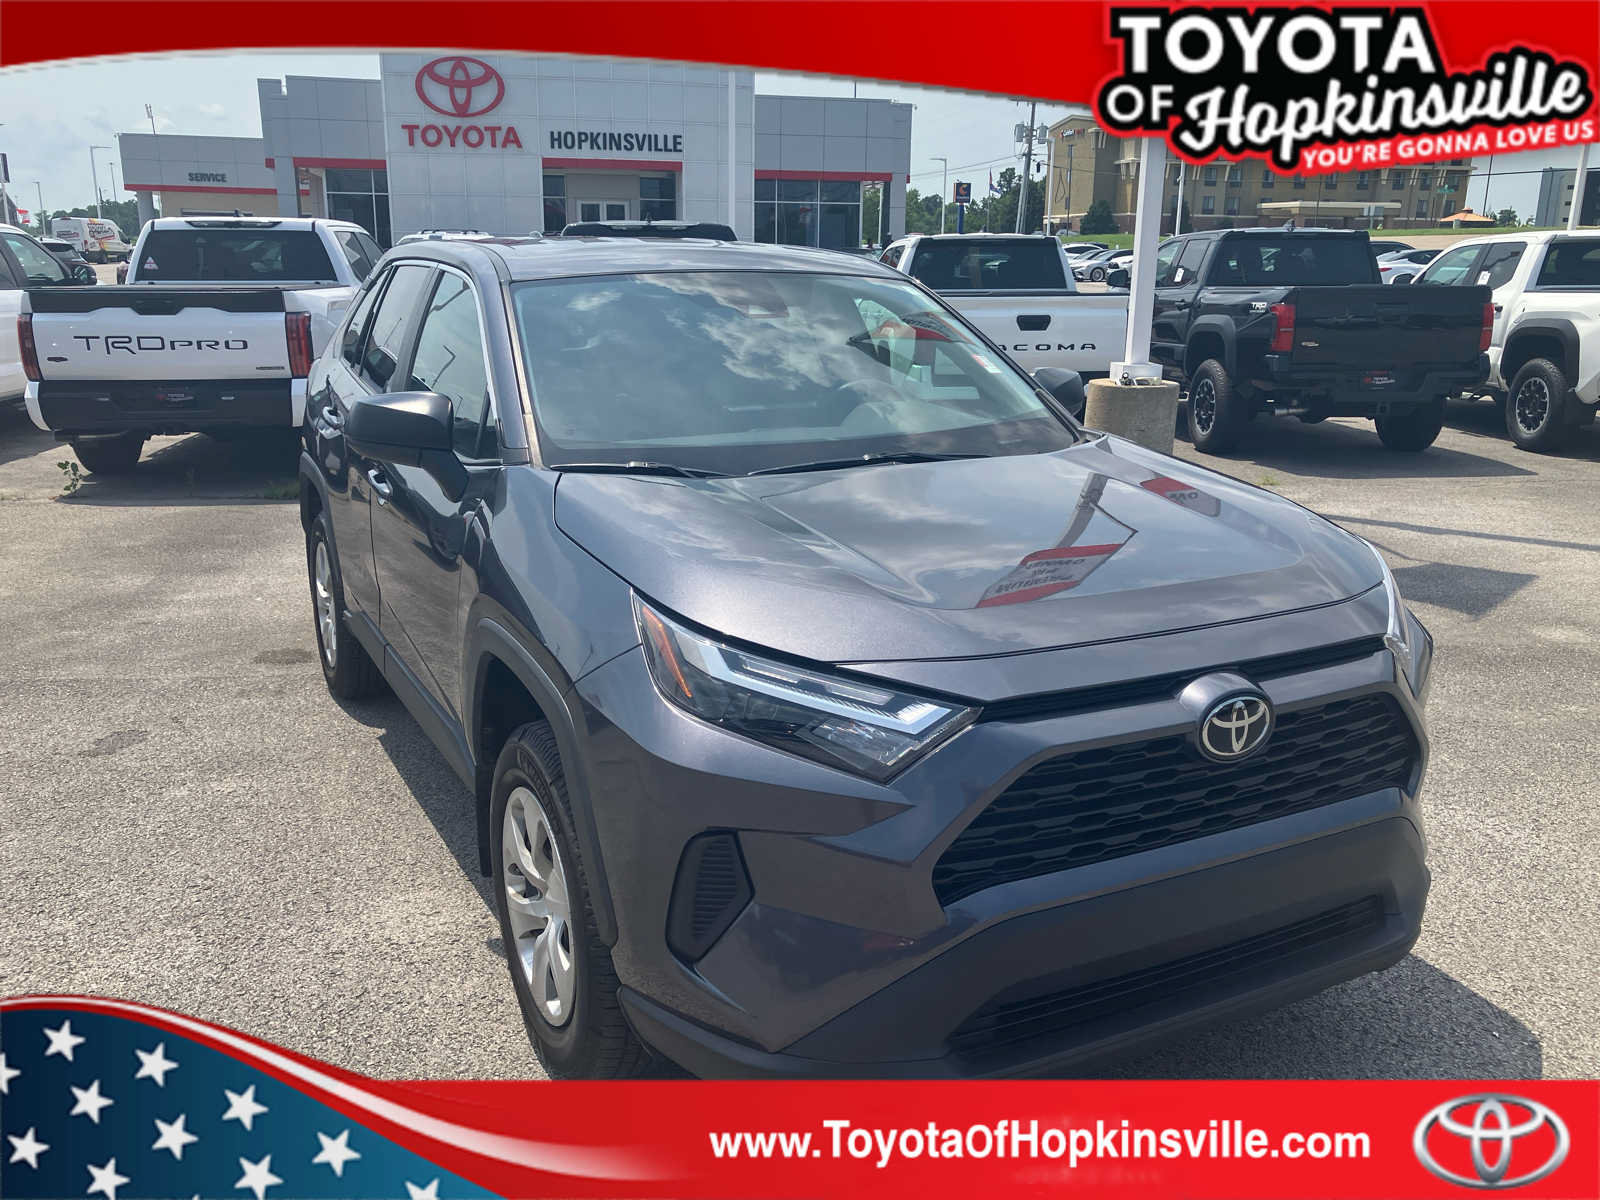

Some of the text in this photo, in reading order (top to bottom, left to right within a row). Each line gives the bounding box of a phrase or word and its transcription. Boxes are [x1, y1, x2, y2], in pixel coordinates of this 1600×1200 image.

[401, 124, 523, 149] TOYOTA
[549, 130, 683, 153] HOPKINSVILLE
[188, 172, 227, 182] SERVICE
